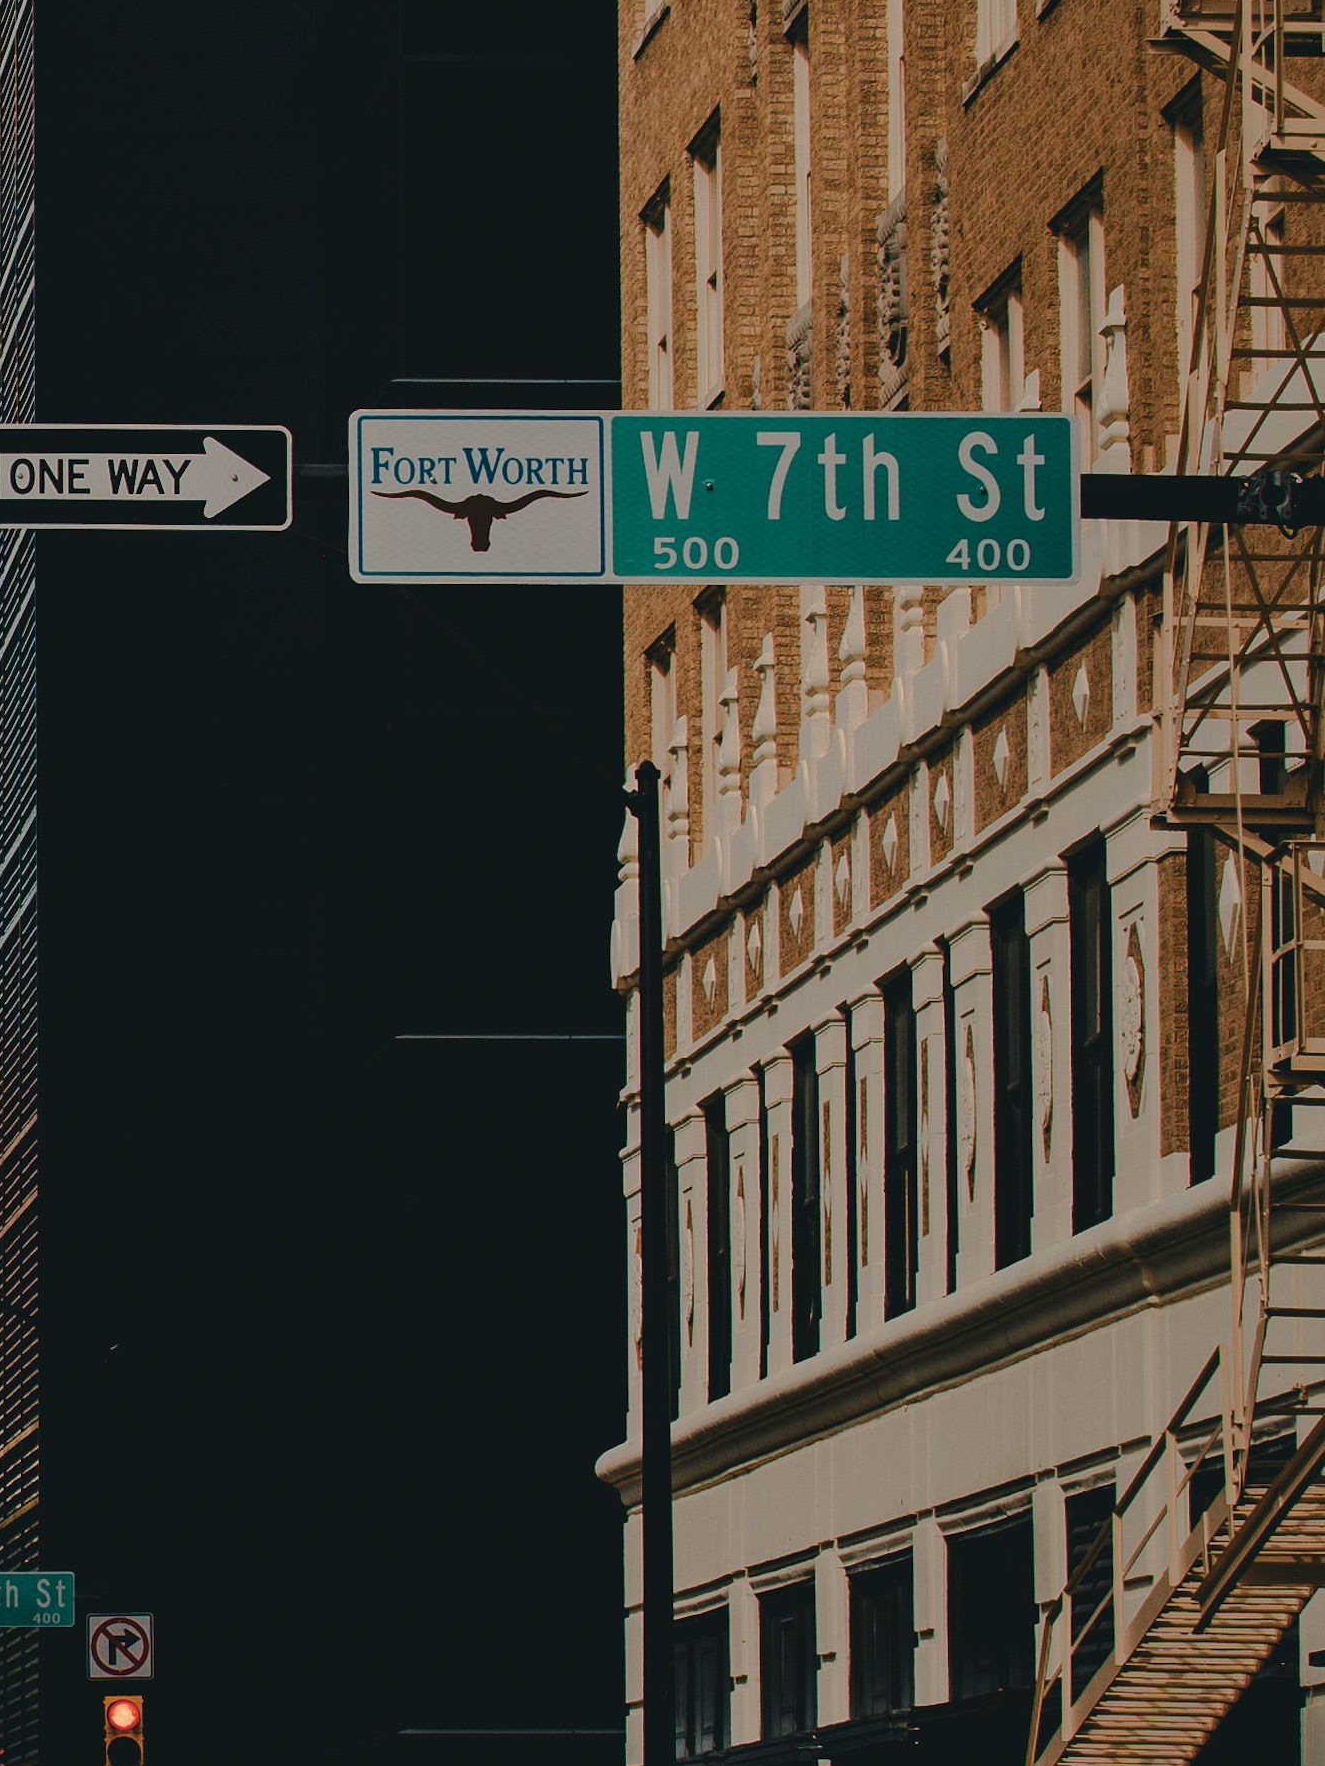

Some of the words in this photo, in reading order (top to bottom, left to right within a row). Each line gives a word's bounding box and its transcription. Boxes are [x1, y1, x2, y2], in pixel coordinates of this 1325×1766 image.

[9, 458, 91, 495] ONE
[108, 458, 192, 495] WAY
[370, 447, 458, 485] FORT
[461, 447, 590, 486] WORTH
[639, 430, 701, 522] W
[756, 431, 901, 522] 7th
[956, 430, 1047, 523] St
[652, 536, 740, 572] 500
[946, 537, 1033, 573] 400
[36, 1578, 67, 1610] St
[32, 1612, 61, 1625] 400
